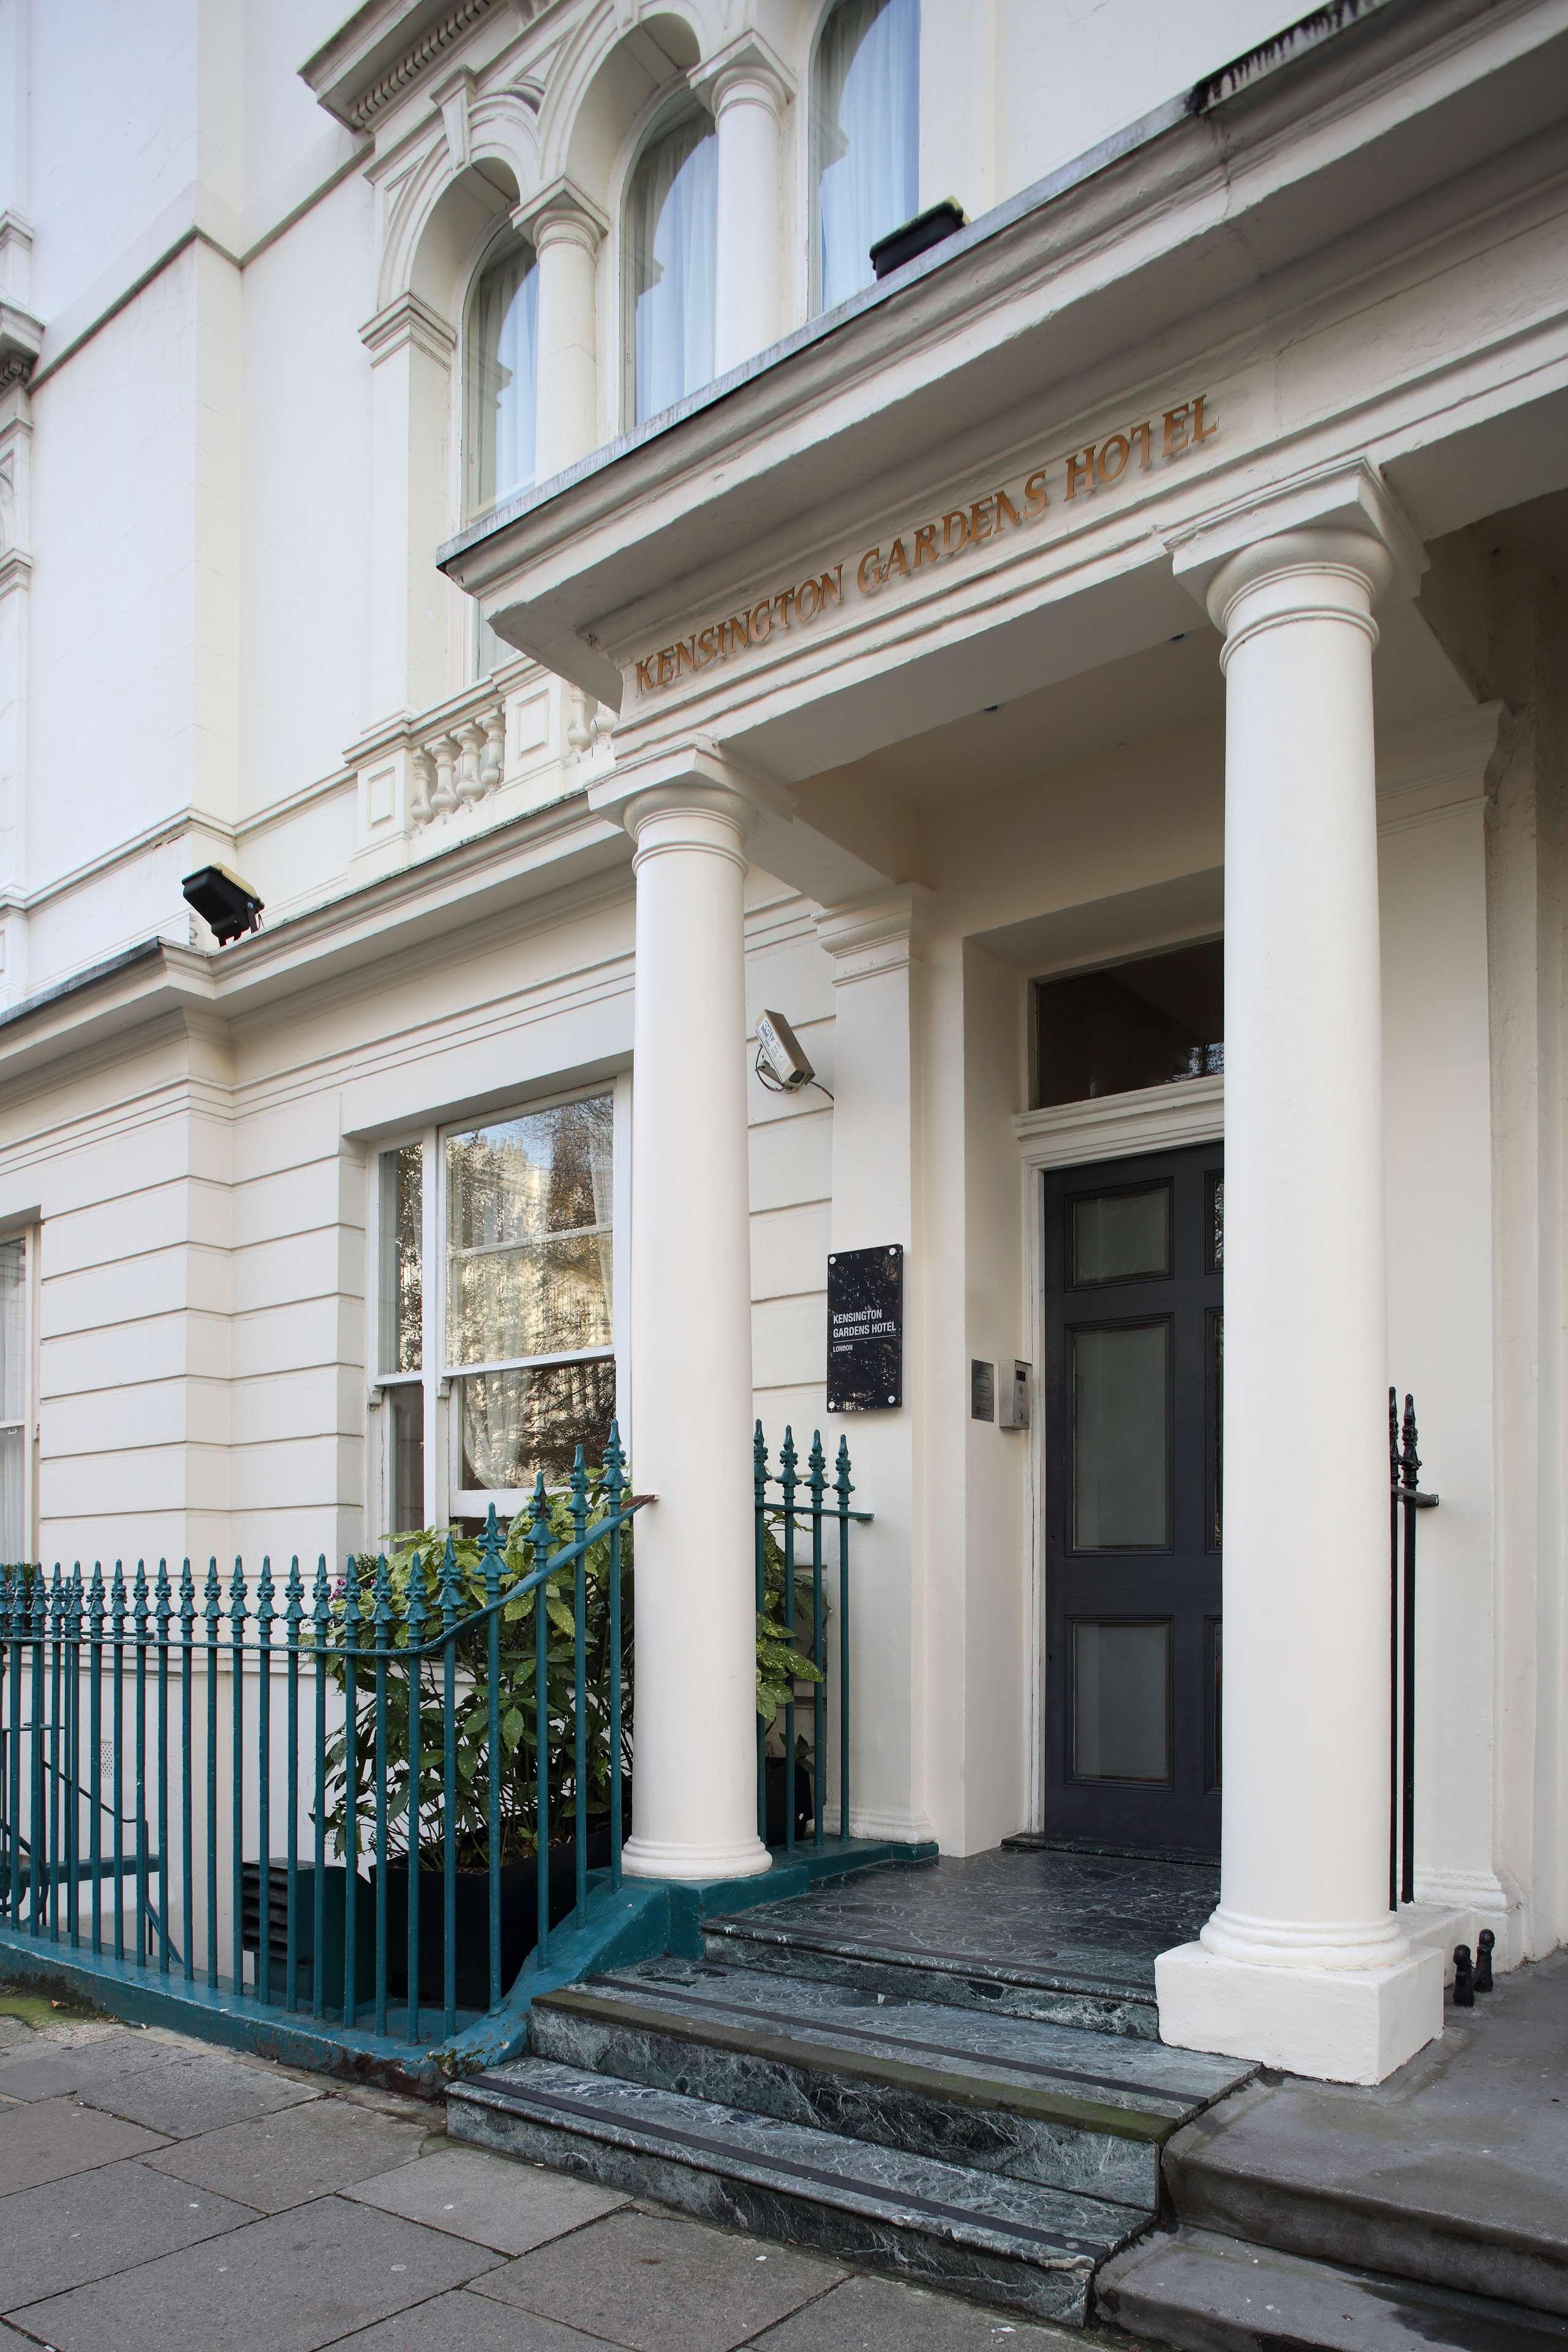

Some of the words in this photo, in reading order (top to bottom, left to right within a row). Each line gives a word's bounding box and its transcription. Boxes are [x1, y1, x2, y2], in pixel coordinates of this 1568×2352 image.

[635, 564, 843, 697] KENSINGTON
[857, 470, 1047, 593] GARDENS
[1064, 394, 1220, 502] HOTEL
[833, 1309, 882, 1324] KENSINGTON
[833, 1325, 869, 1338] GARDENS
[872, 1322, 896, 1333] HOTEL
